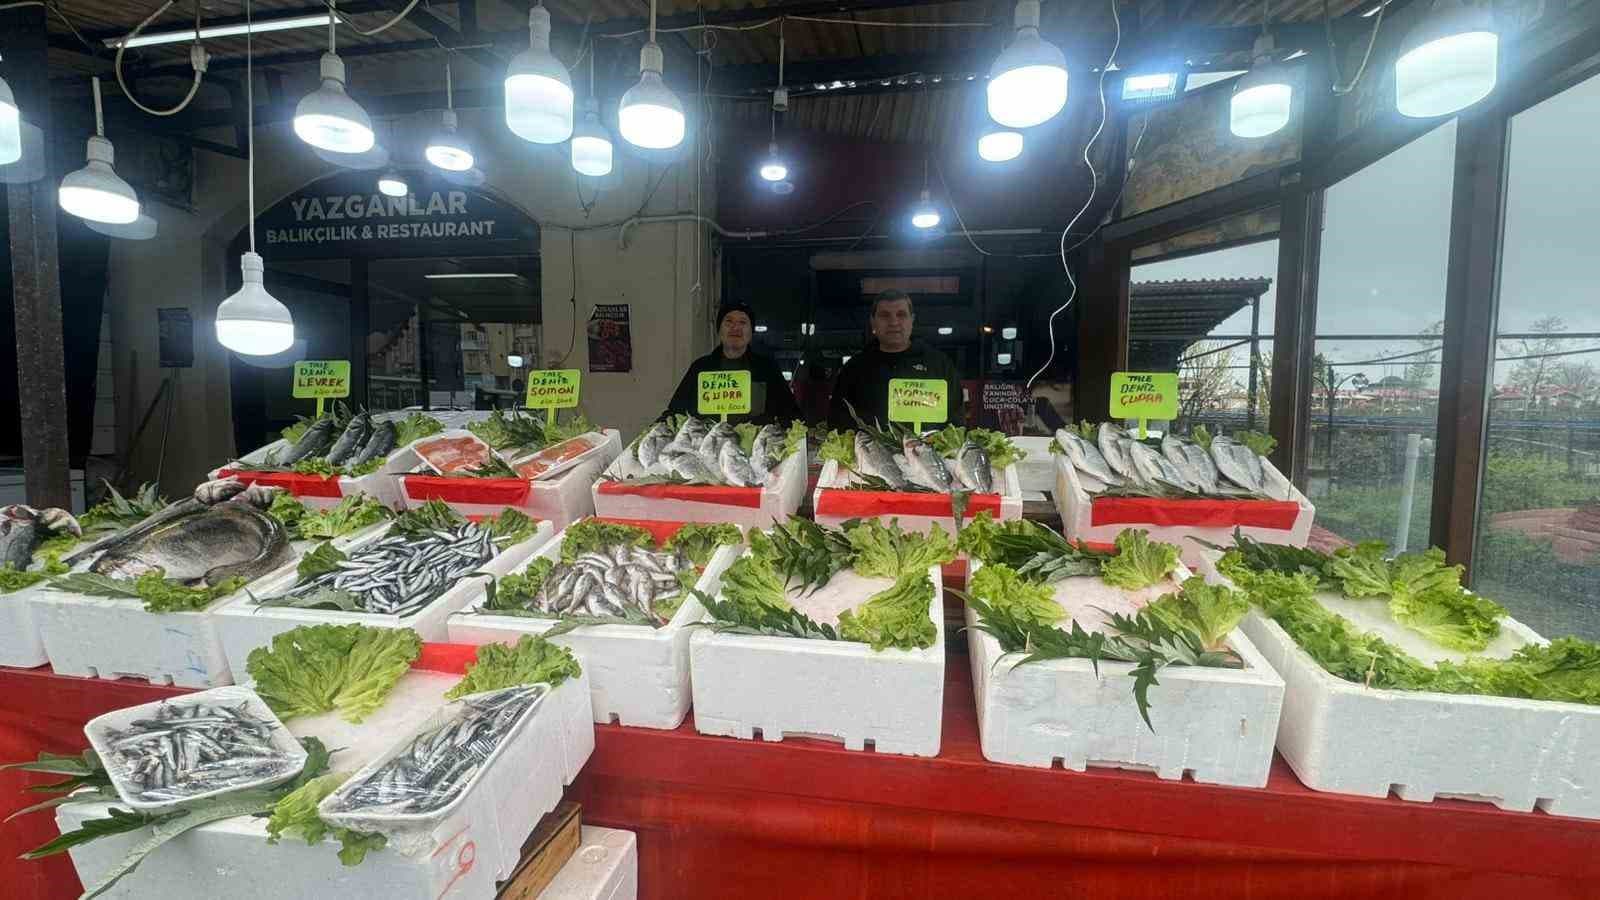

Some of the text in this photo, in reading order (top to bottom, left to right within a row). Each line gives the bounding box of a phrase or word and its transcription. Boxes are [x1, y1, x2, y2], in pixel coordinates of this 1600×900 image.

[292, 191, 467, 221] YAZGANLAR
[266, 220, 495, 244] BALIKÇILIK & RESTAURANT
[298, 377, 345, 388] LEVREK
